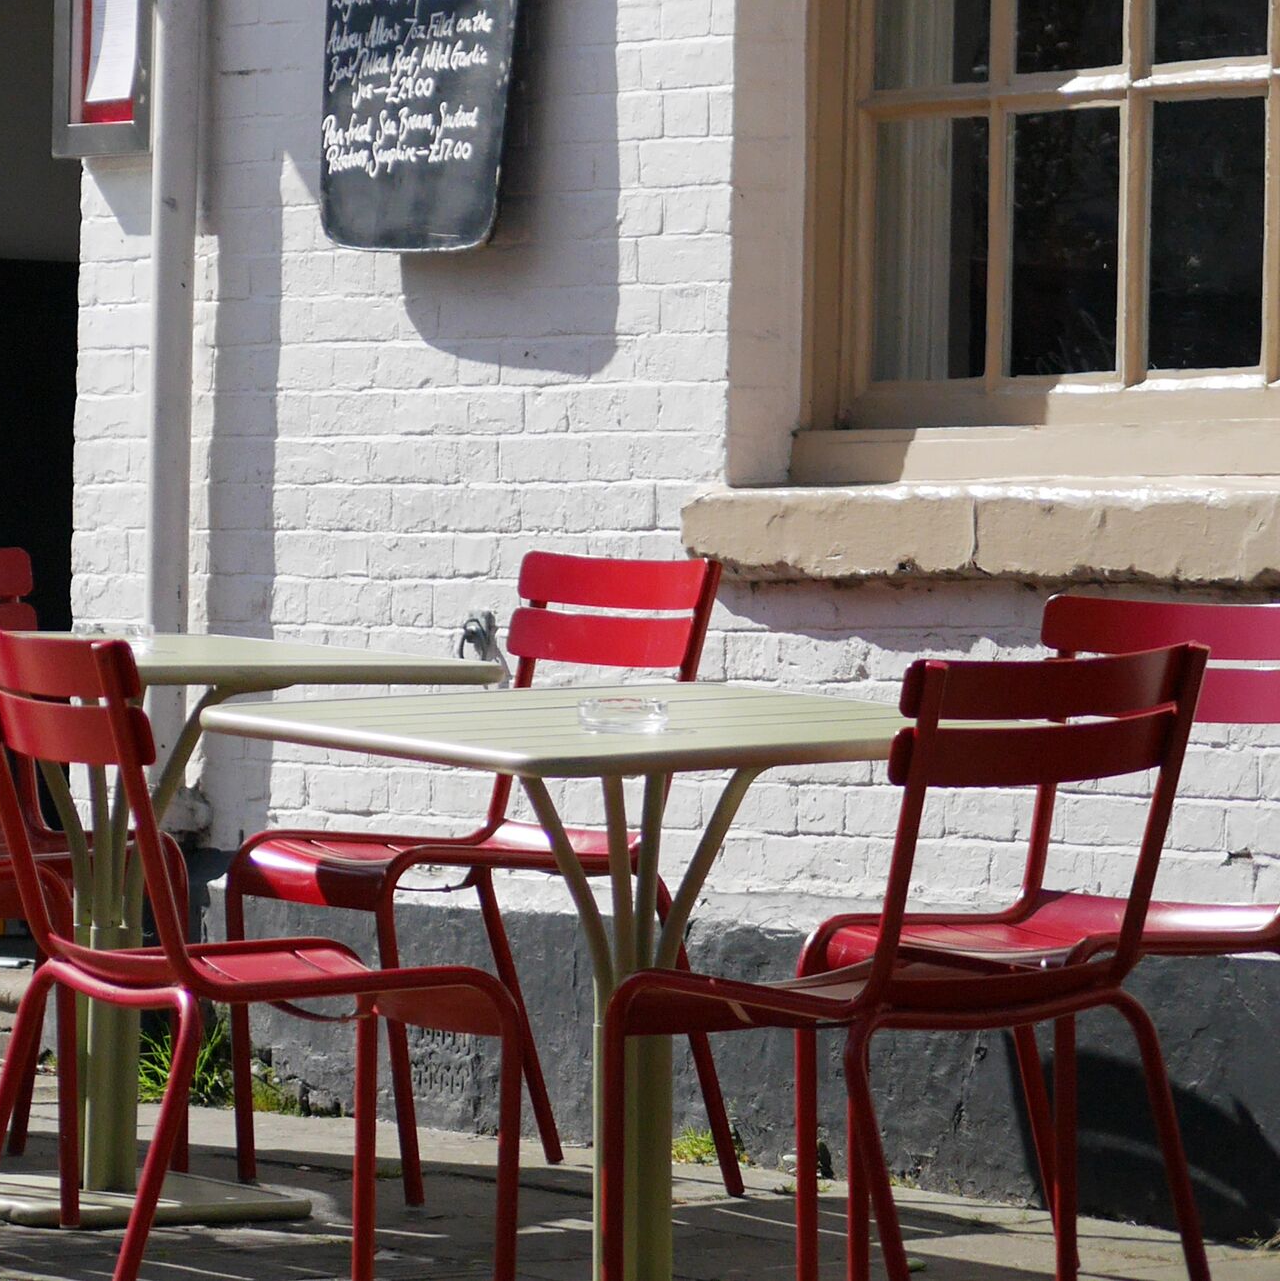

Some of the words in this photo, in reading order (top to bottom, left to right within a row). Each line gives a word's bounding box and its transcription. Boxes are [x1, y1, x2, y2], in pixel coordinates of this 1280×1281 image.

[456, 19, 472, 33] on
[472, 9, 493, 33] the
[421, 40, 450, 71] Wild
[450, 39, 488, 71] Garlic
[376, 109, 397, 145] Sea
